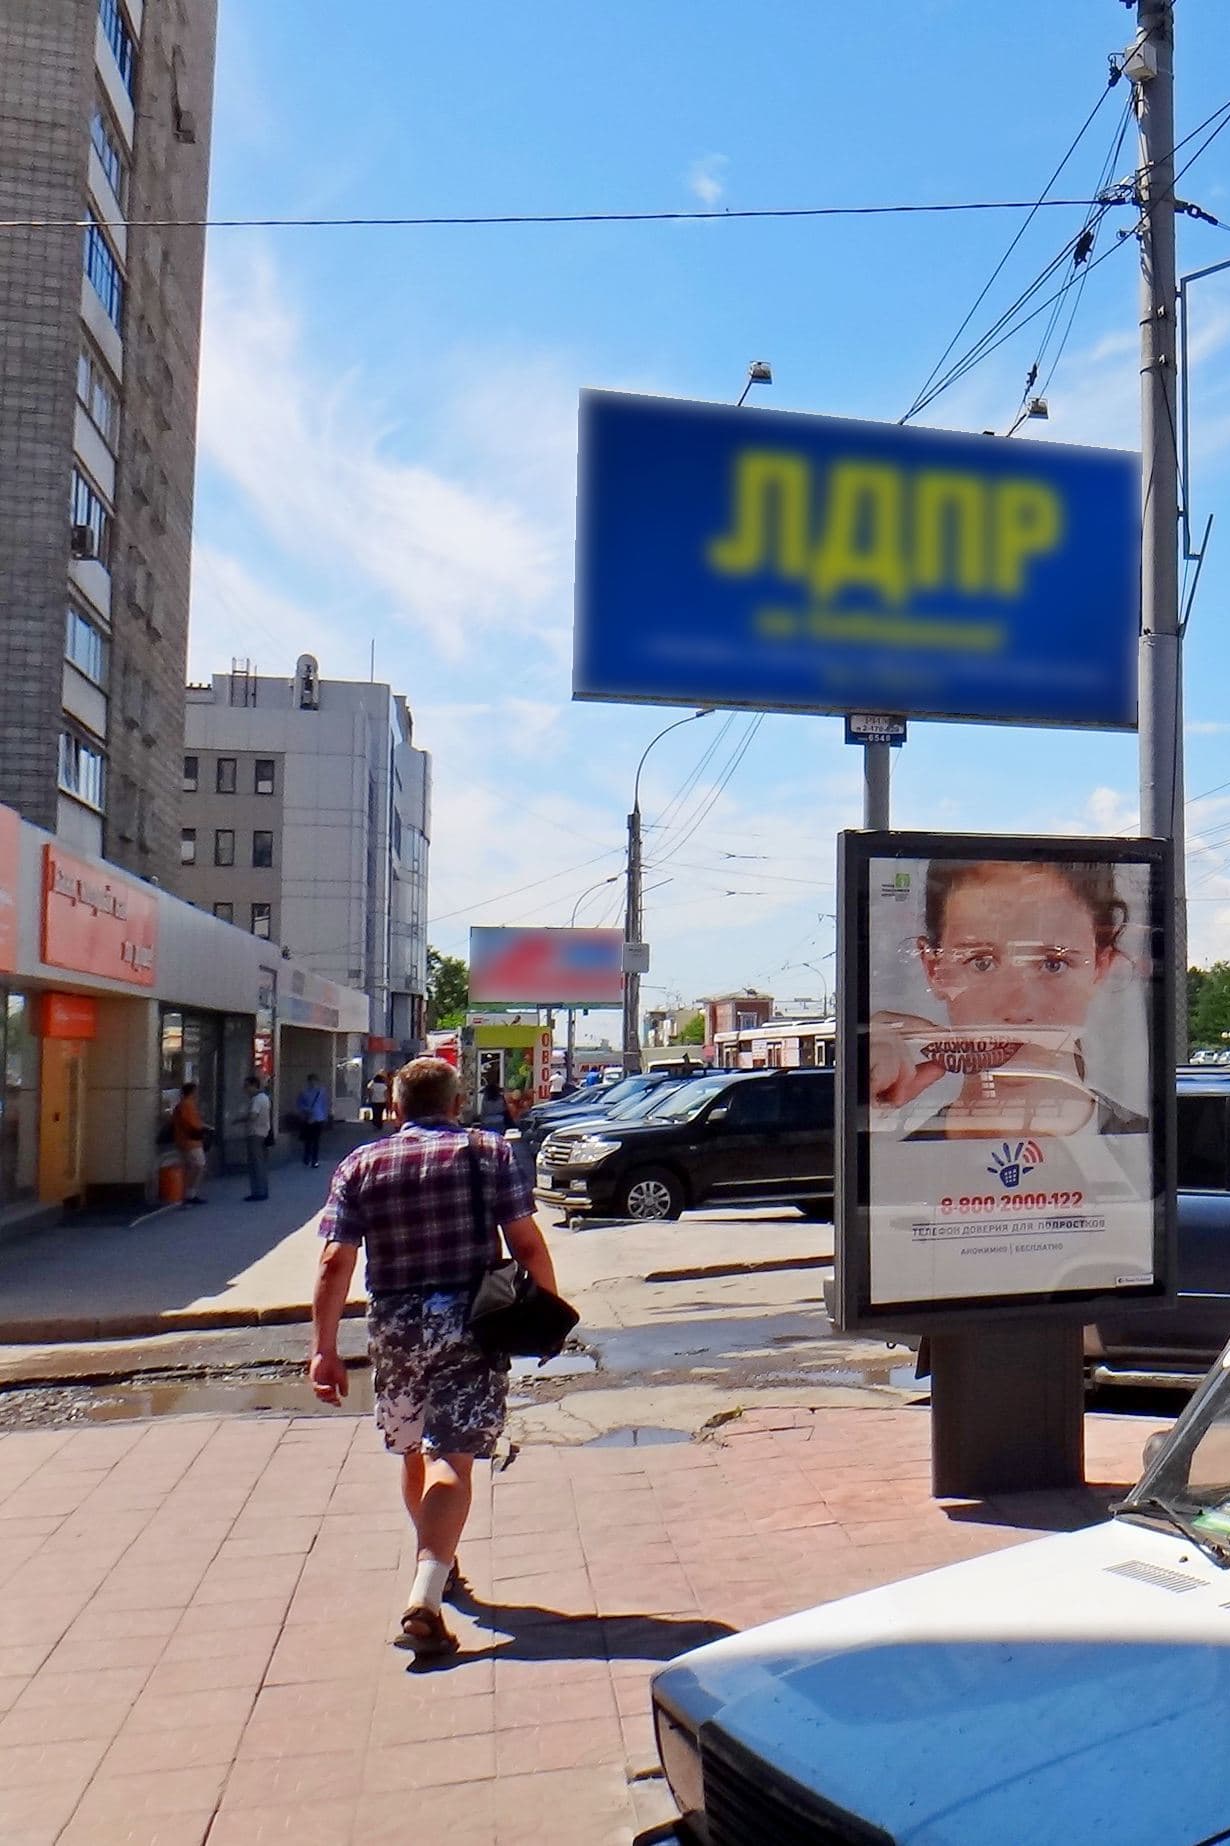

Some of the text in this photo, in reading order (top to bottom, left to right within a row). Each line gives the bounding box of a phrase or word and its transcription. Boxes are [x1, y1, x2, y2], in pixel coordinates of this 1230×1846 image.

[710, 450, 1064, 604] ЛДПР
[912, 1226, 960, 1237] ТЕЛЕФОН
[962, 1223, 1009, 1235] ДОВЕРИЯ
[1012, 1222, 1034, 1233] ДЛЯ
[1015, 1243, 1064, 1253] БЕСПЛАТНО
